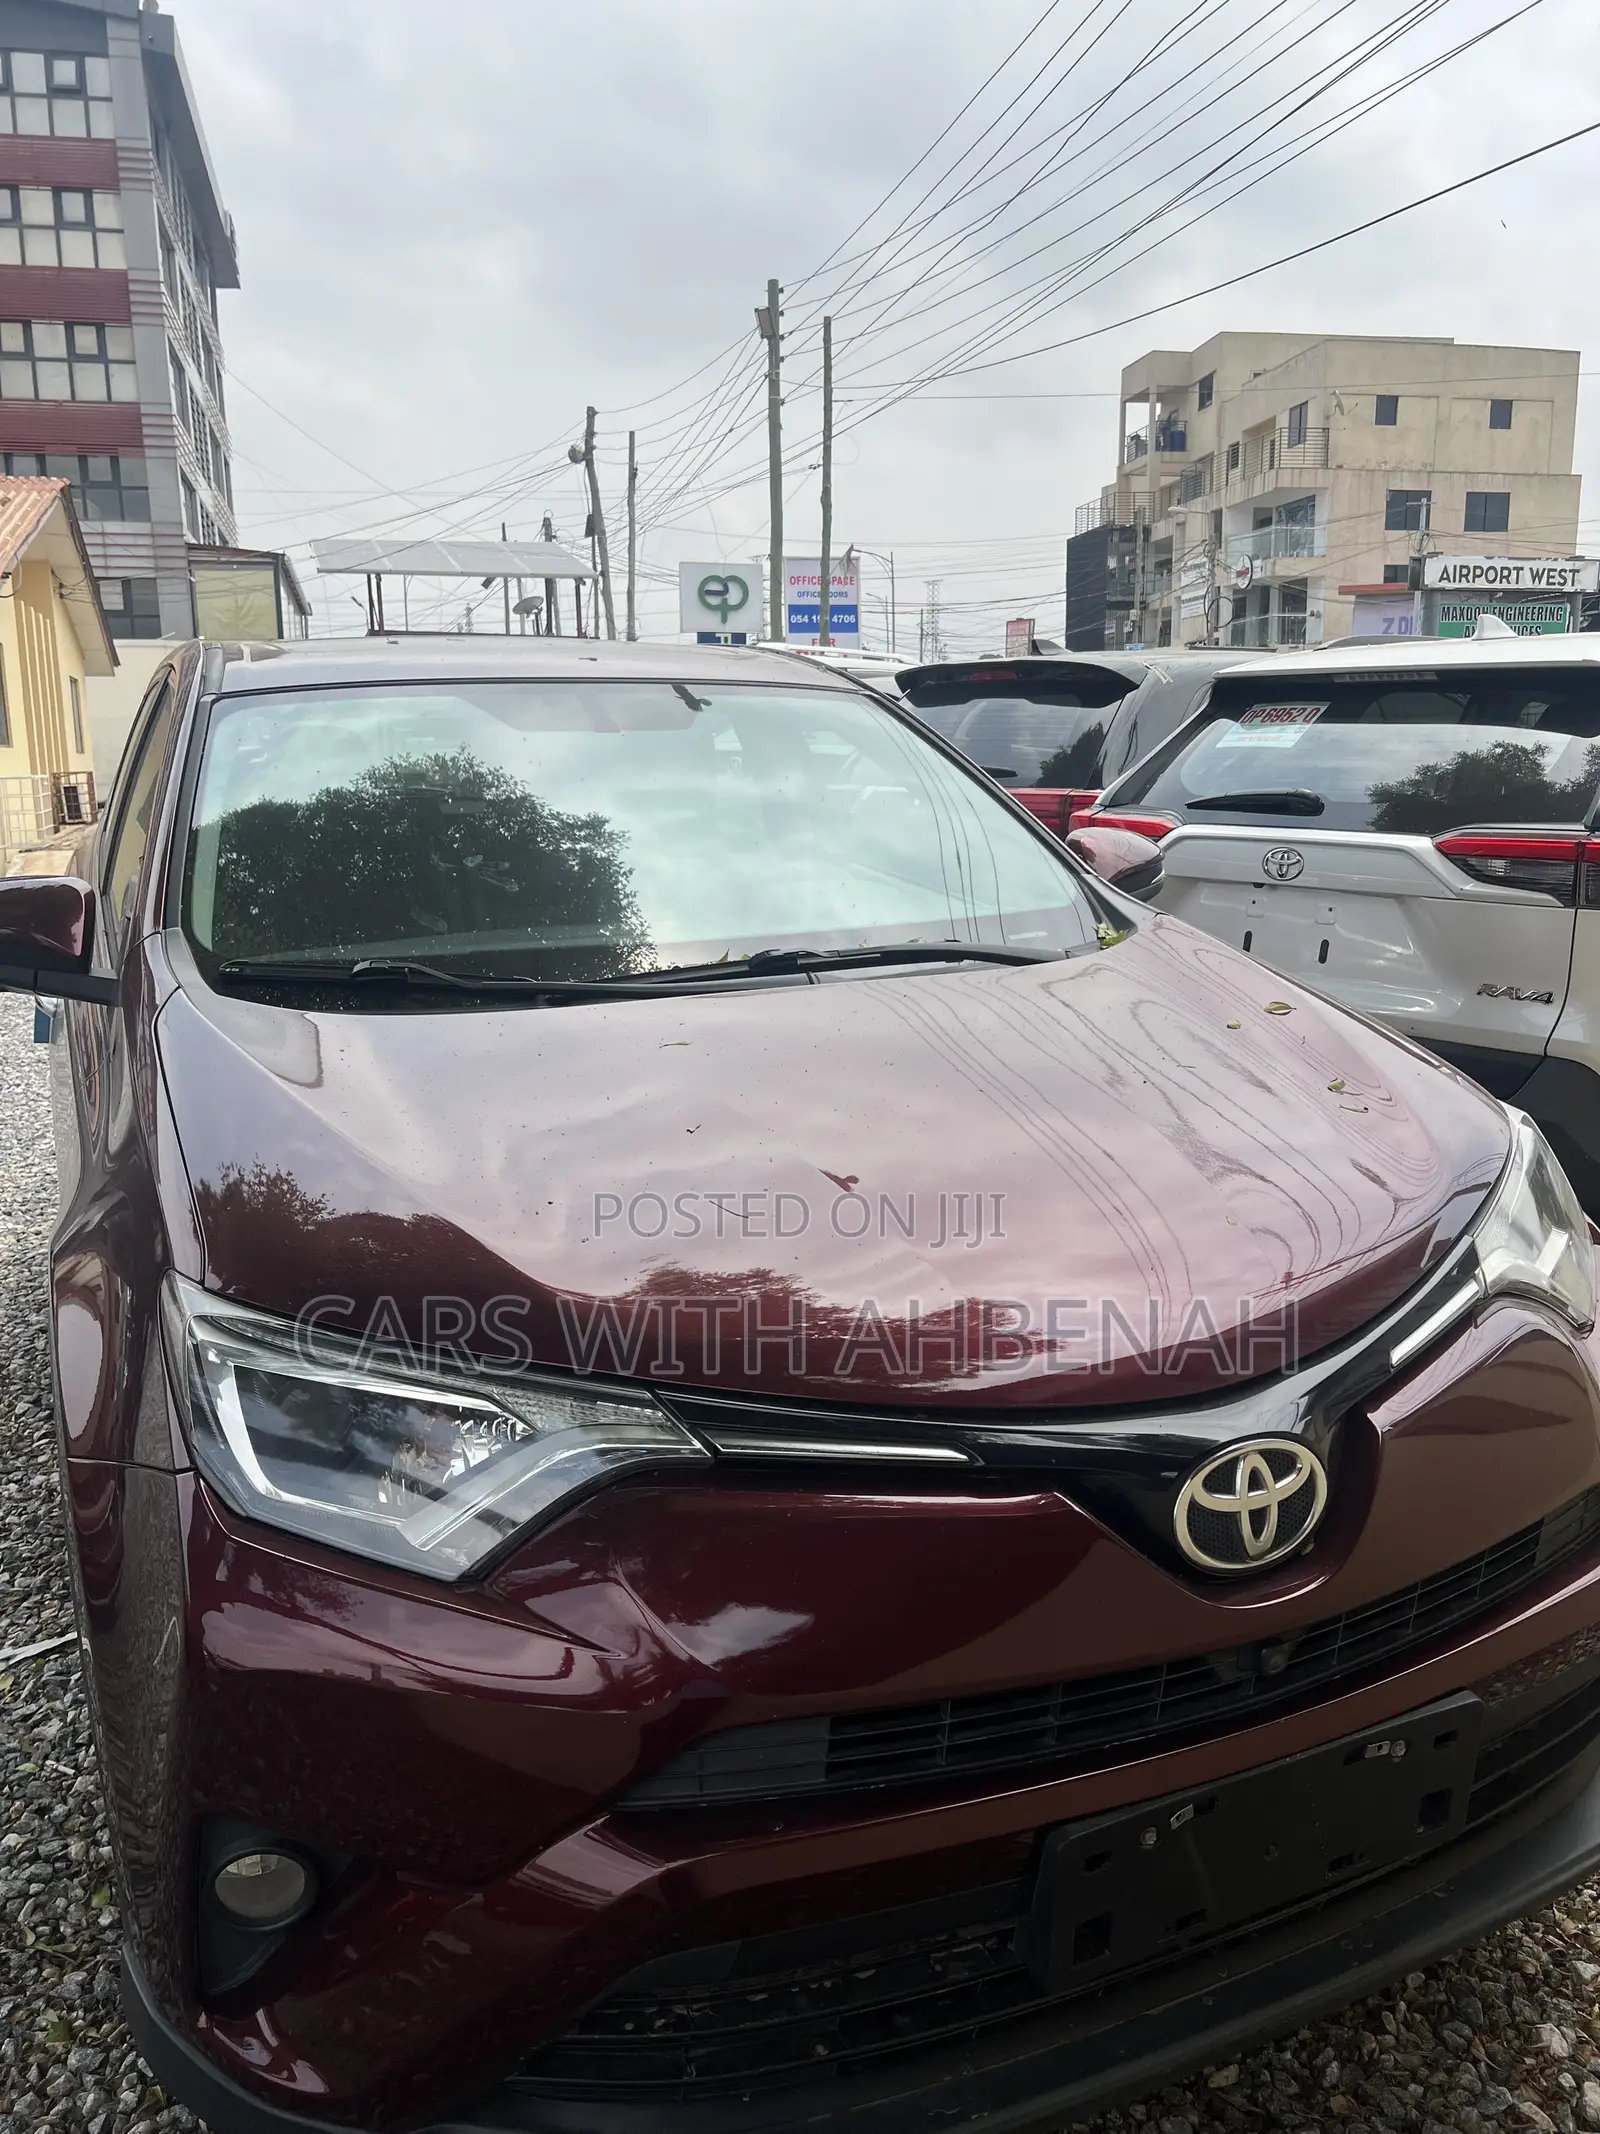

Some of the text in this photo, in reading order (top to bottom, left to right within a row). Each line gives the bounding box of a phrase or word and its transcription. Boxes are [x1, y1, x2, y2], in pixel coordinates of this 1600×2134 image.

[789, 575, 822, 586] OFFICE
[1438, 565, 1580, 587] AIRPORT WEST
[790, 615, 809, 624] 054
[832, 614, 856, 624] 4706
[1492, 606, 1563, 622] ENGINEERING
[812, 638, 836, 647] FR
[1476, 983, 1555, 1004] RAV4
